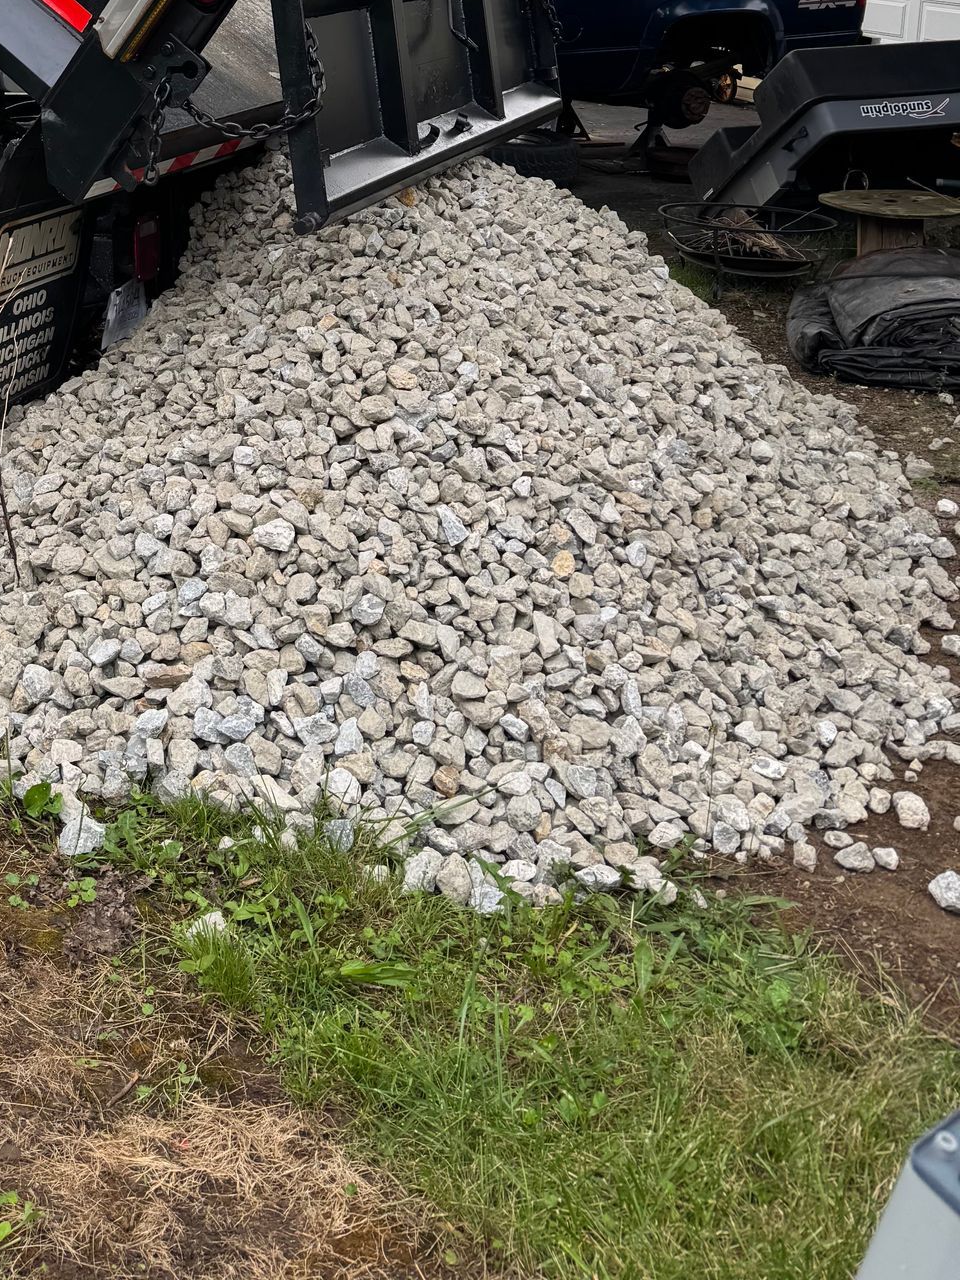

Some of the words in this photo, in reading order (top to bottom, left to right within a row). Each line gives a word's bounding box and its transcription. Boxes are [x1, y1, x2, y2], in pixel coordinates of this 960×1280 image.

[860, 100, 933, 118] sundolphin
[26, 252, 74, 277] EQUIPMENT
[12, 289, 47, 316] OHIO
